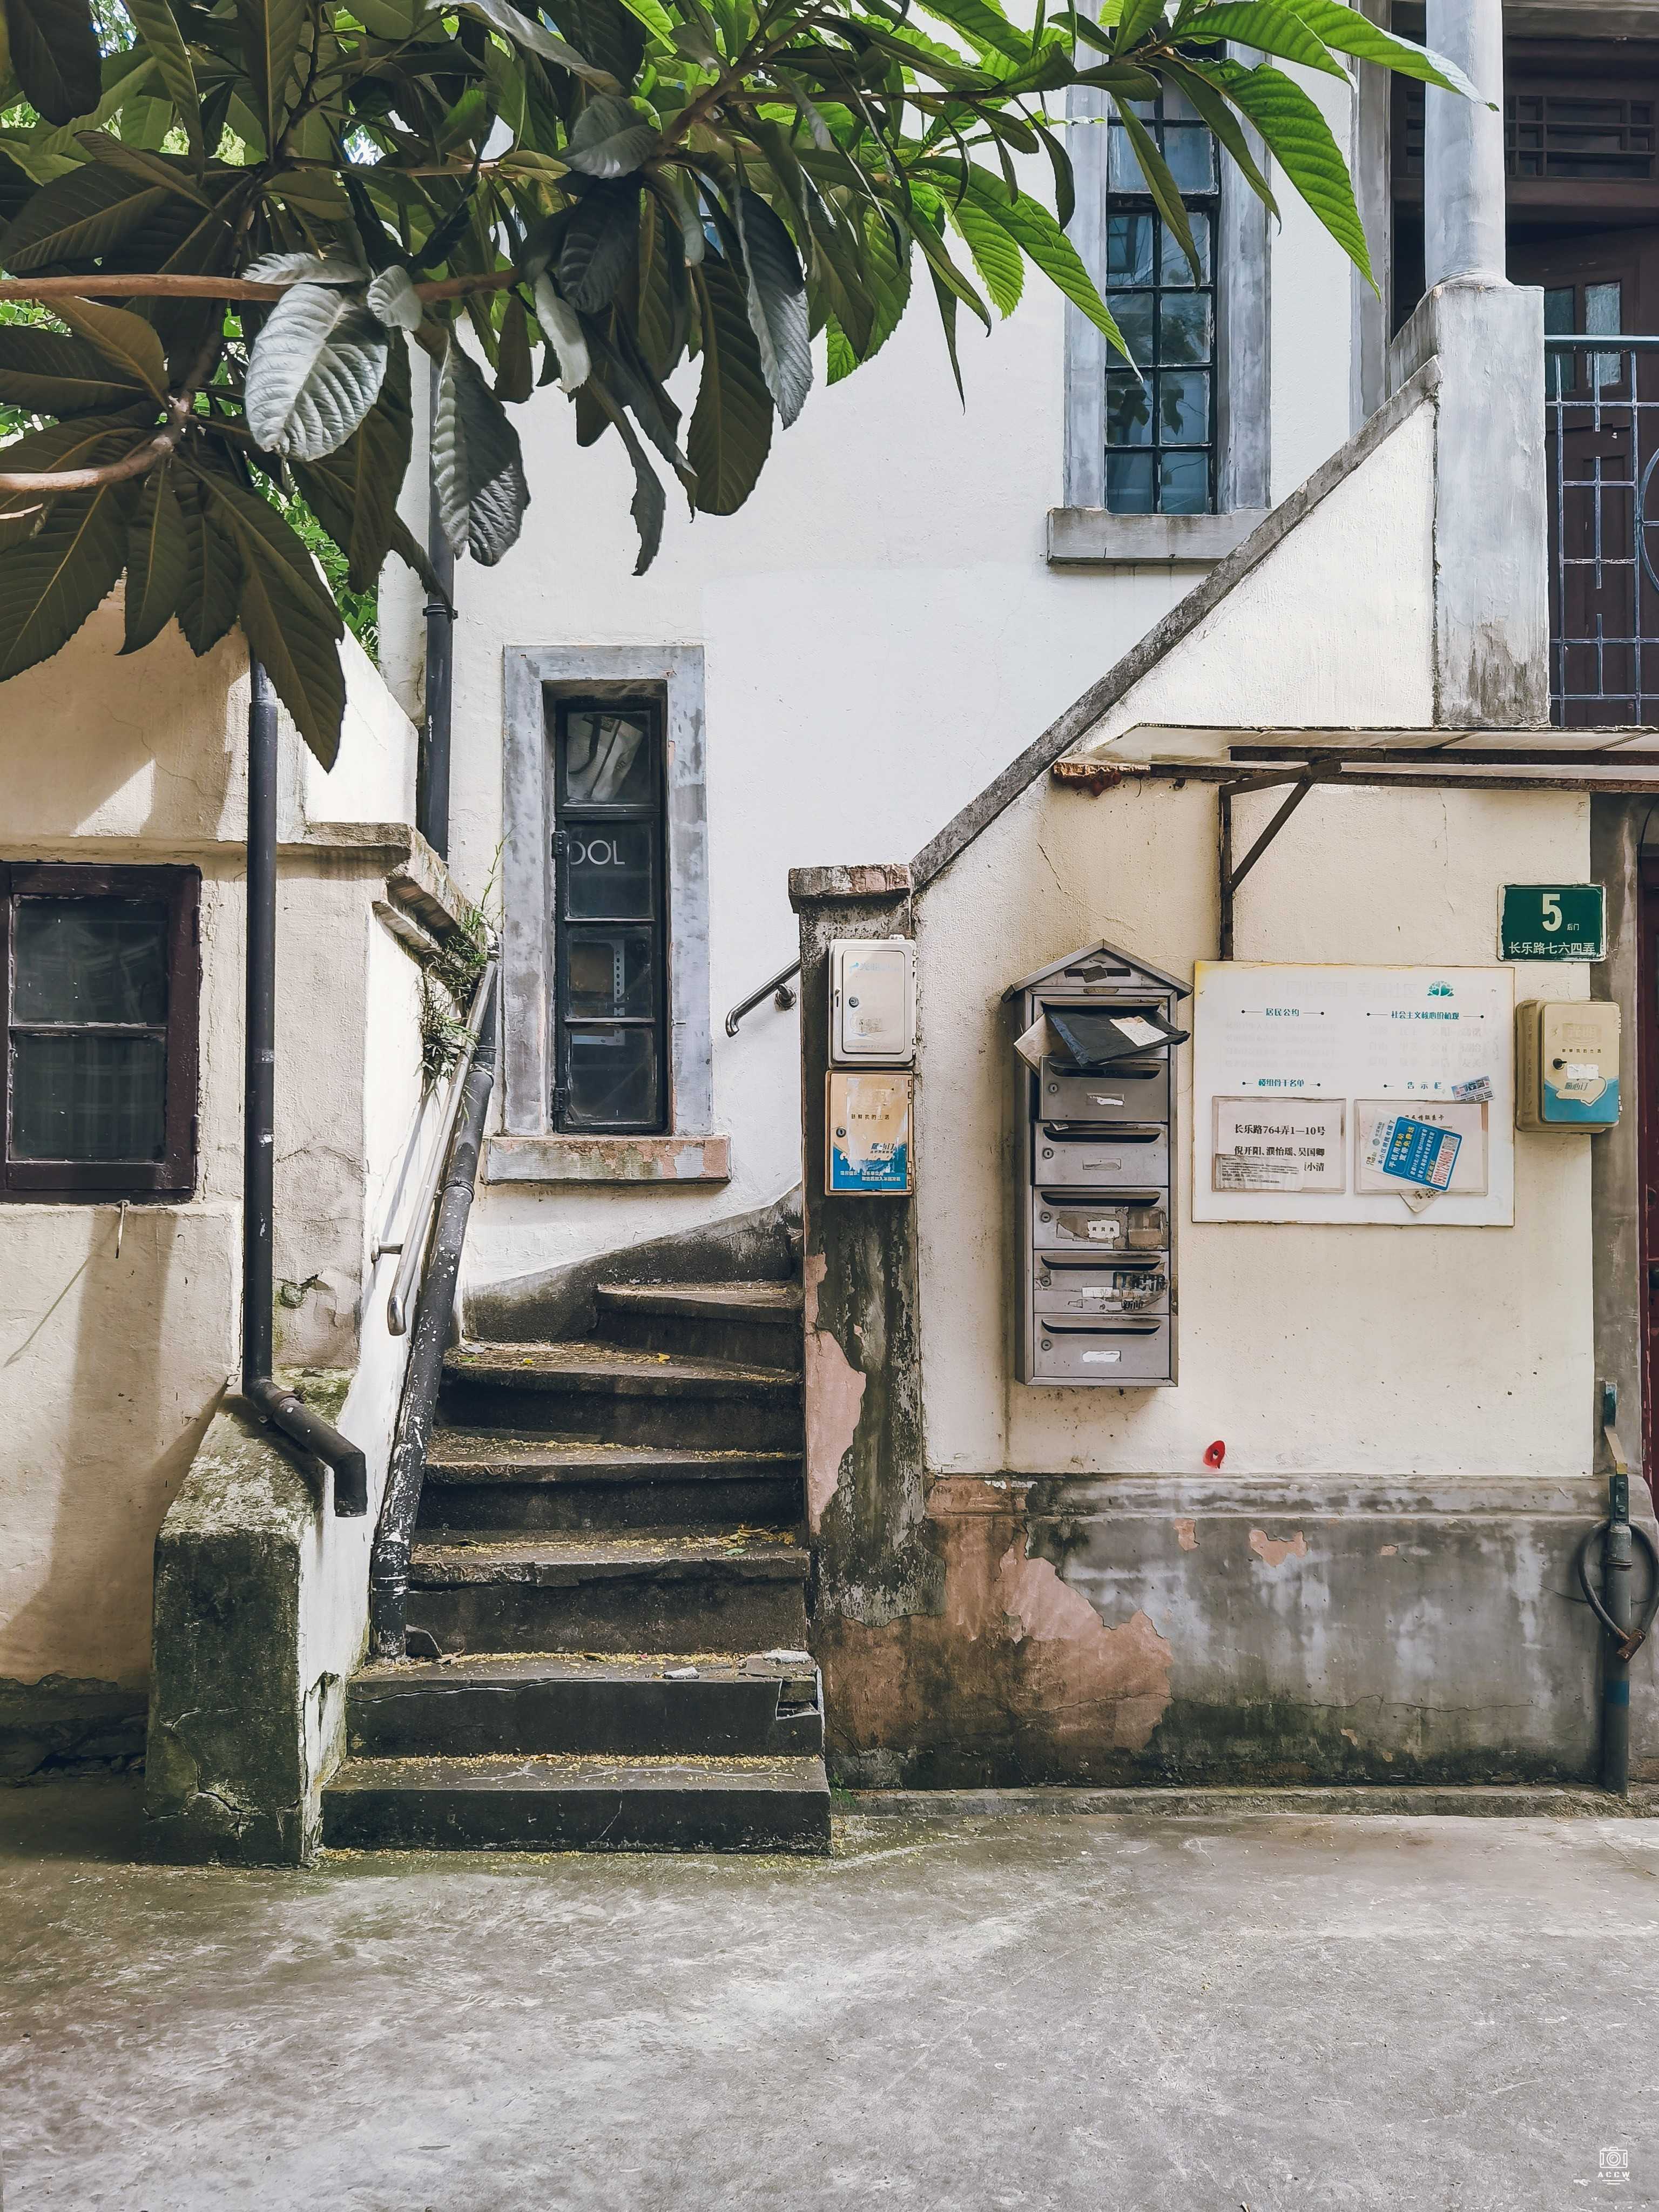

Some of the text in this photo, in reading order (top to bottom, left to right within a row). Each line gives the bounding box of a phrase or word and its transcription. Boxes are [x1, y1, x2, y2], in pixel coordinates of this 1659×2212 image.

[1542, 894, 1562, 932] 5
[1509, 942, 1595, 955] 长乐路七六四弄
[1266, 1008, 1299, 1016] 居民公约
